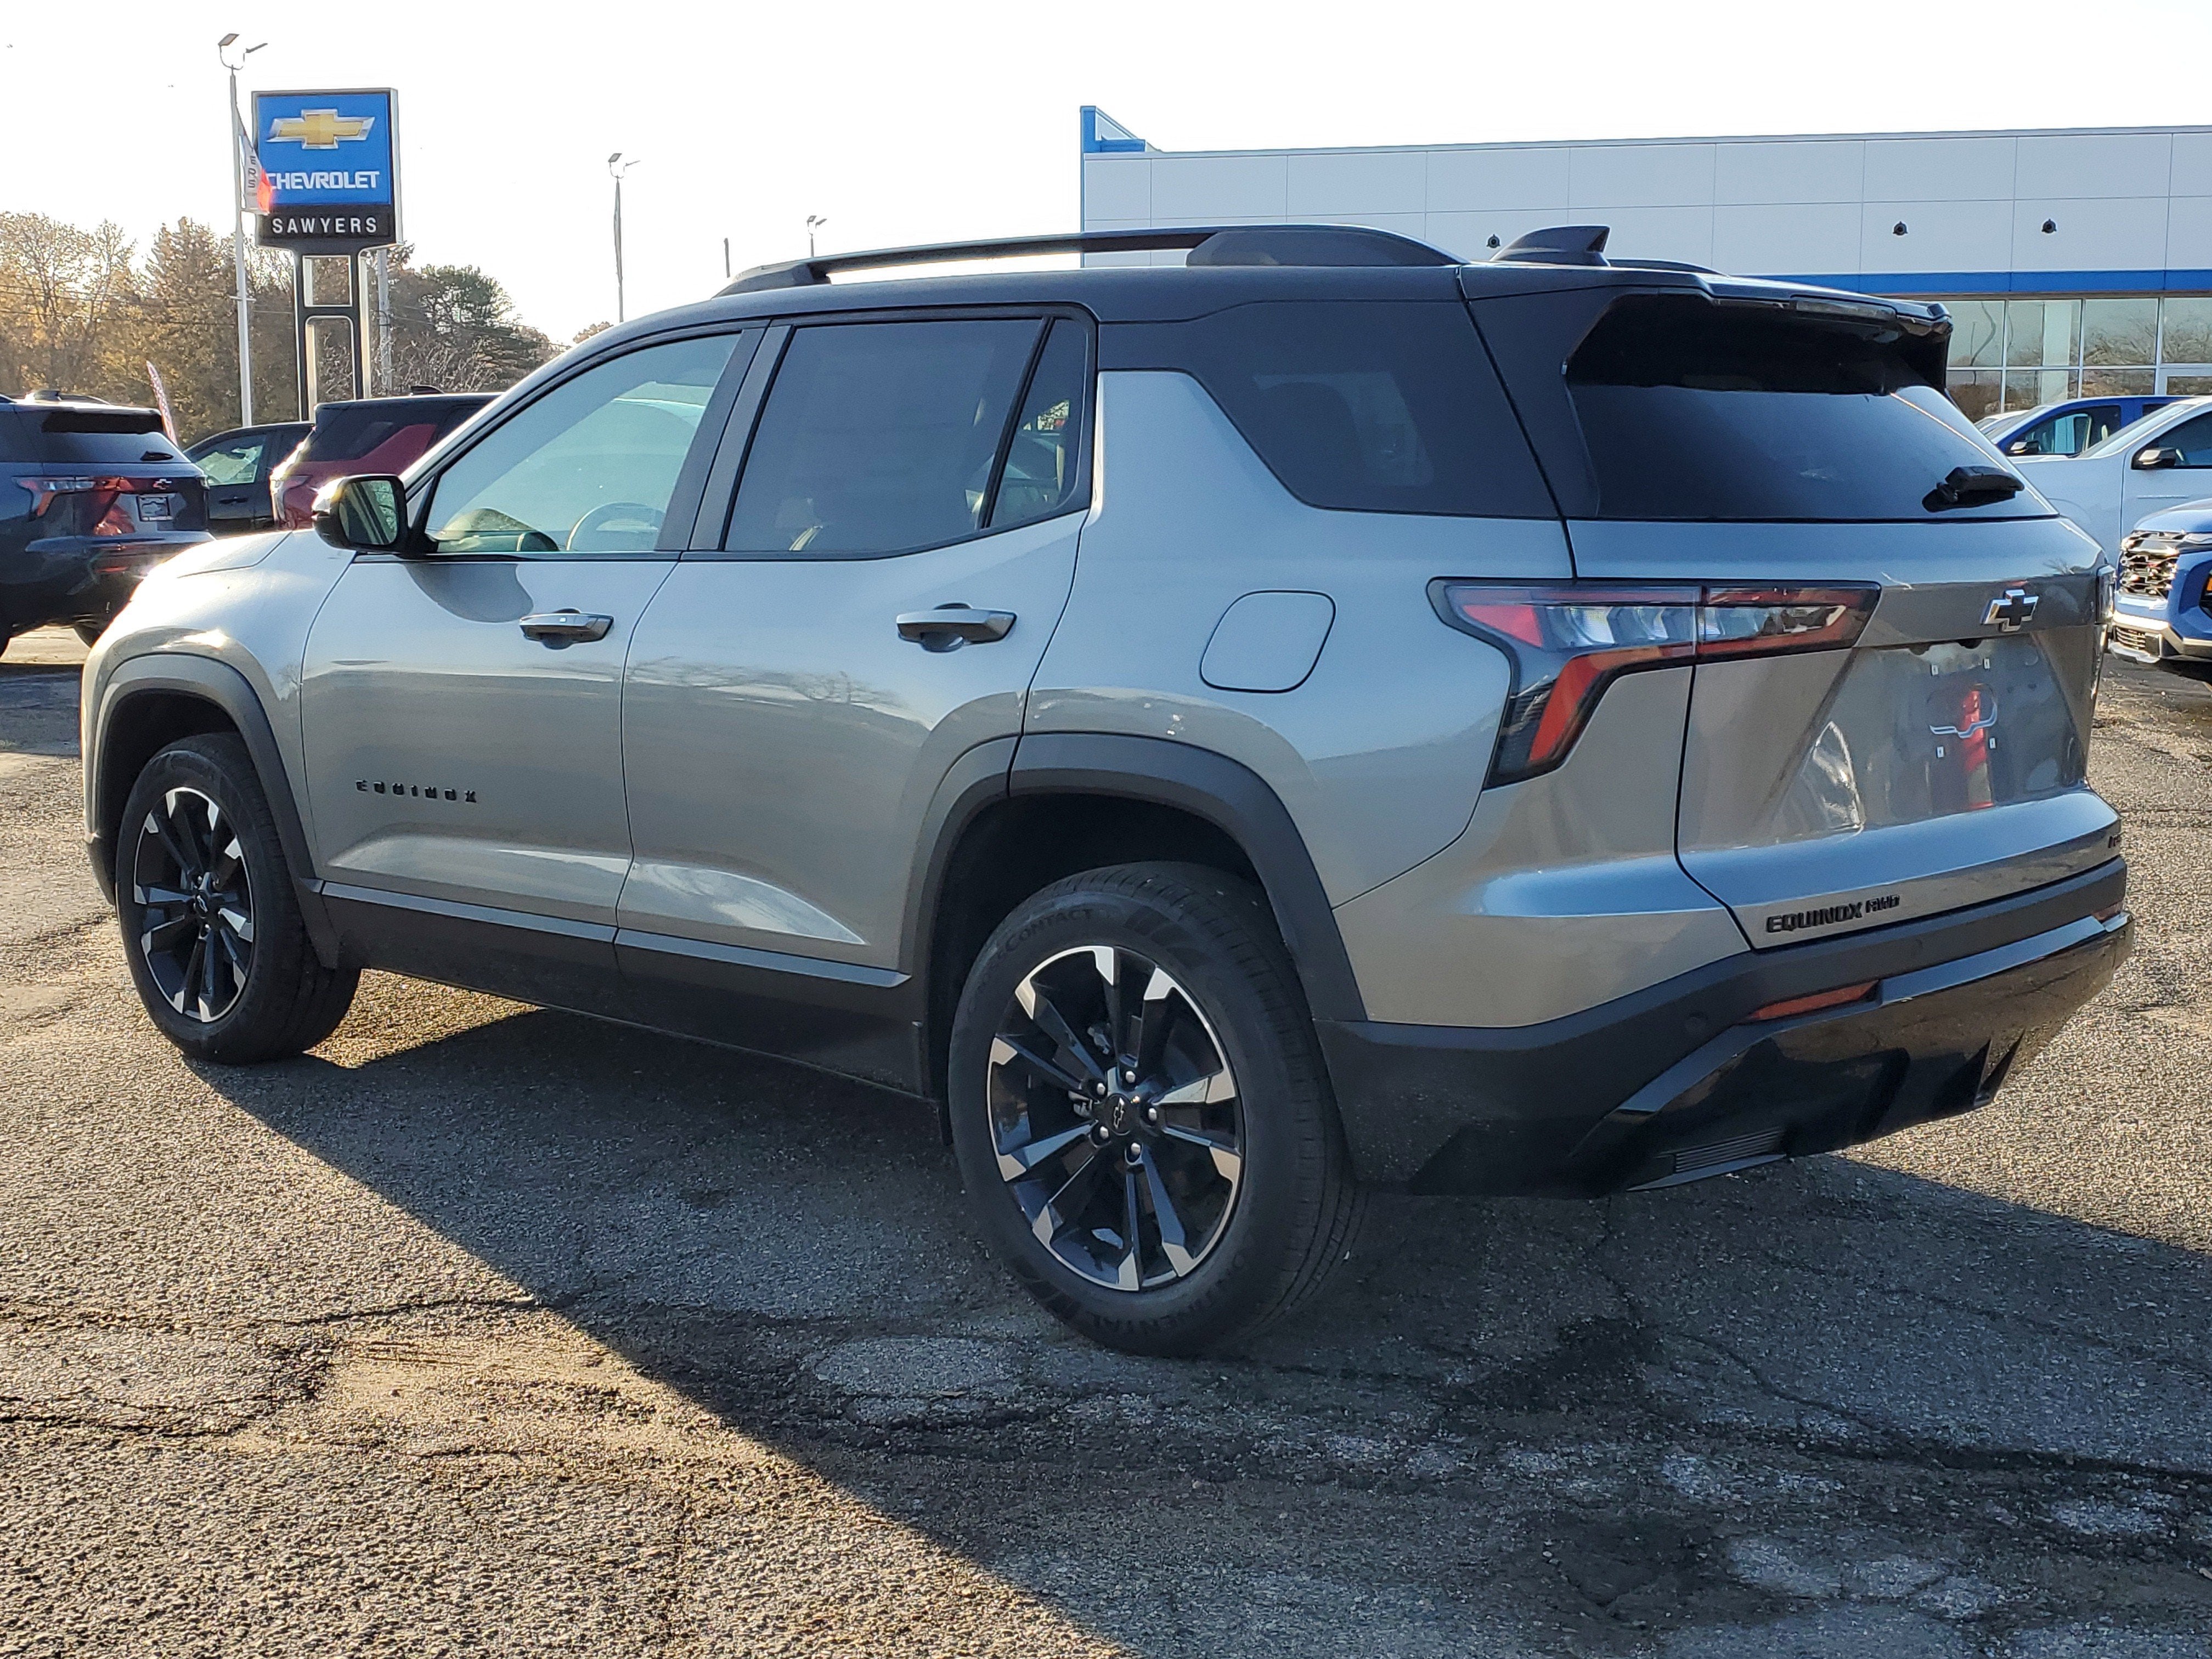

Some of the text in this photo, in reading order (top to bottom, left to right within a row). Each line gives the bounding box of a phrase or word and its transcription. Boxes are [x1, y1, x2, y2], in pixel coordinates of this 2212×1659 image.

[266, 171, 380, 189] CHEVROLET
[272, 218, 377, 233] SAWYERS
[1766, 894, 1900, 933] EQUINOX AWD
